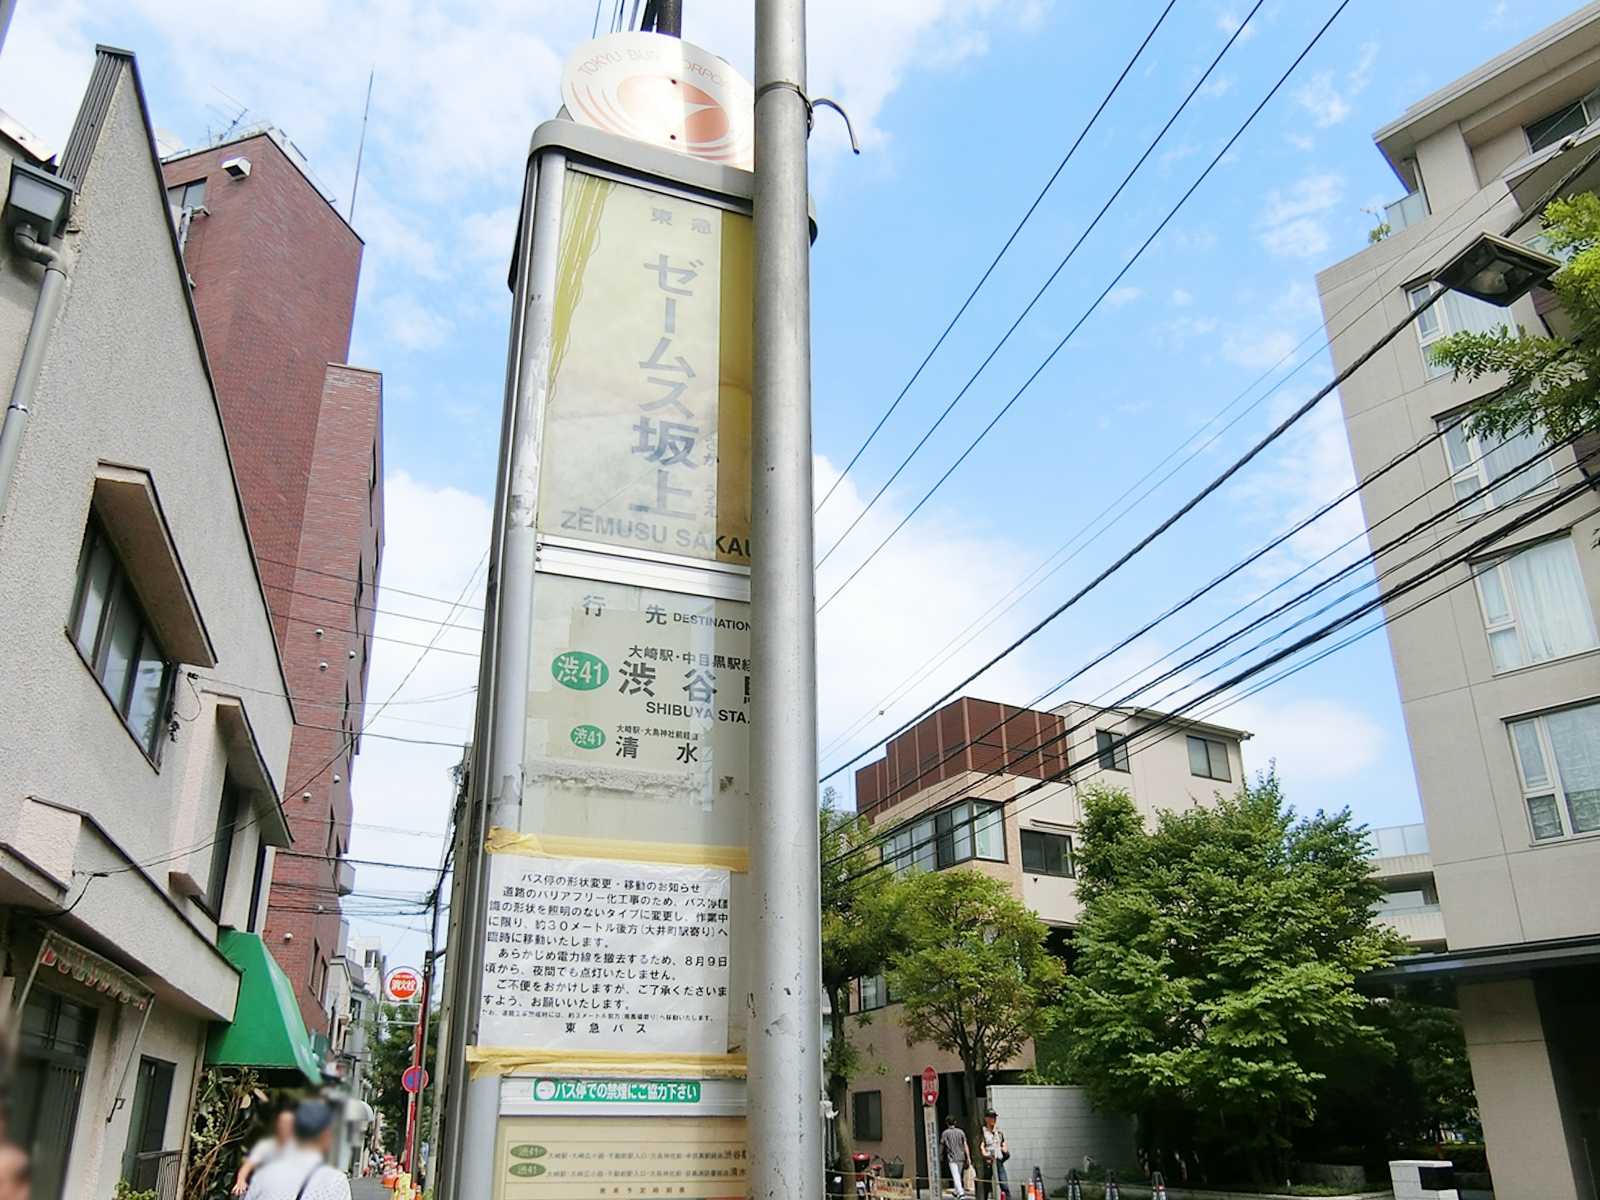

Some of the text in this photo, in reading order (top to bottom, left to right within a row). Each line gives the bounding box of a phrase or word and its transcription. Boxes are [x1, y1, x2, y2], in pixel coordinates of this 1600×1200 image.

[578, 51, 622, 77] TOKYU
[627, 49, 661, 62] BUS
[650, 207, 712, 236] 東急
[629, 253, 701, 521] ゼームス坂上
[557, 655, 603, 685] 渋41
[646, 701, 751, 724] SHIBUYA STA.
[574, 728, 698, 764] 渋41 清水
[521, 873, 701, 893] バス停の形状変更・移動のお知らせ
[554, 1081, 697, 1100] バス停での禁煙にご協力下さい
